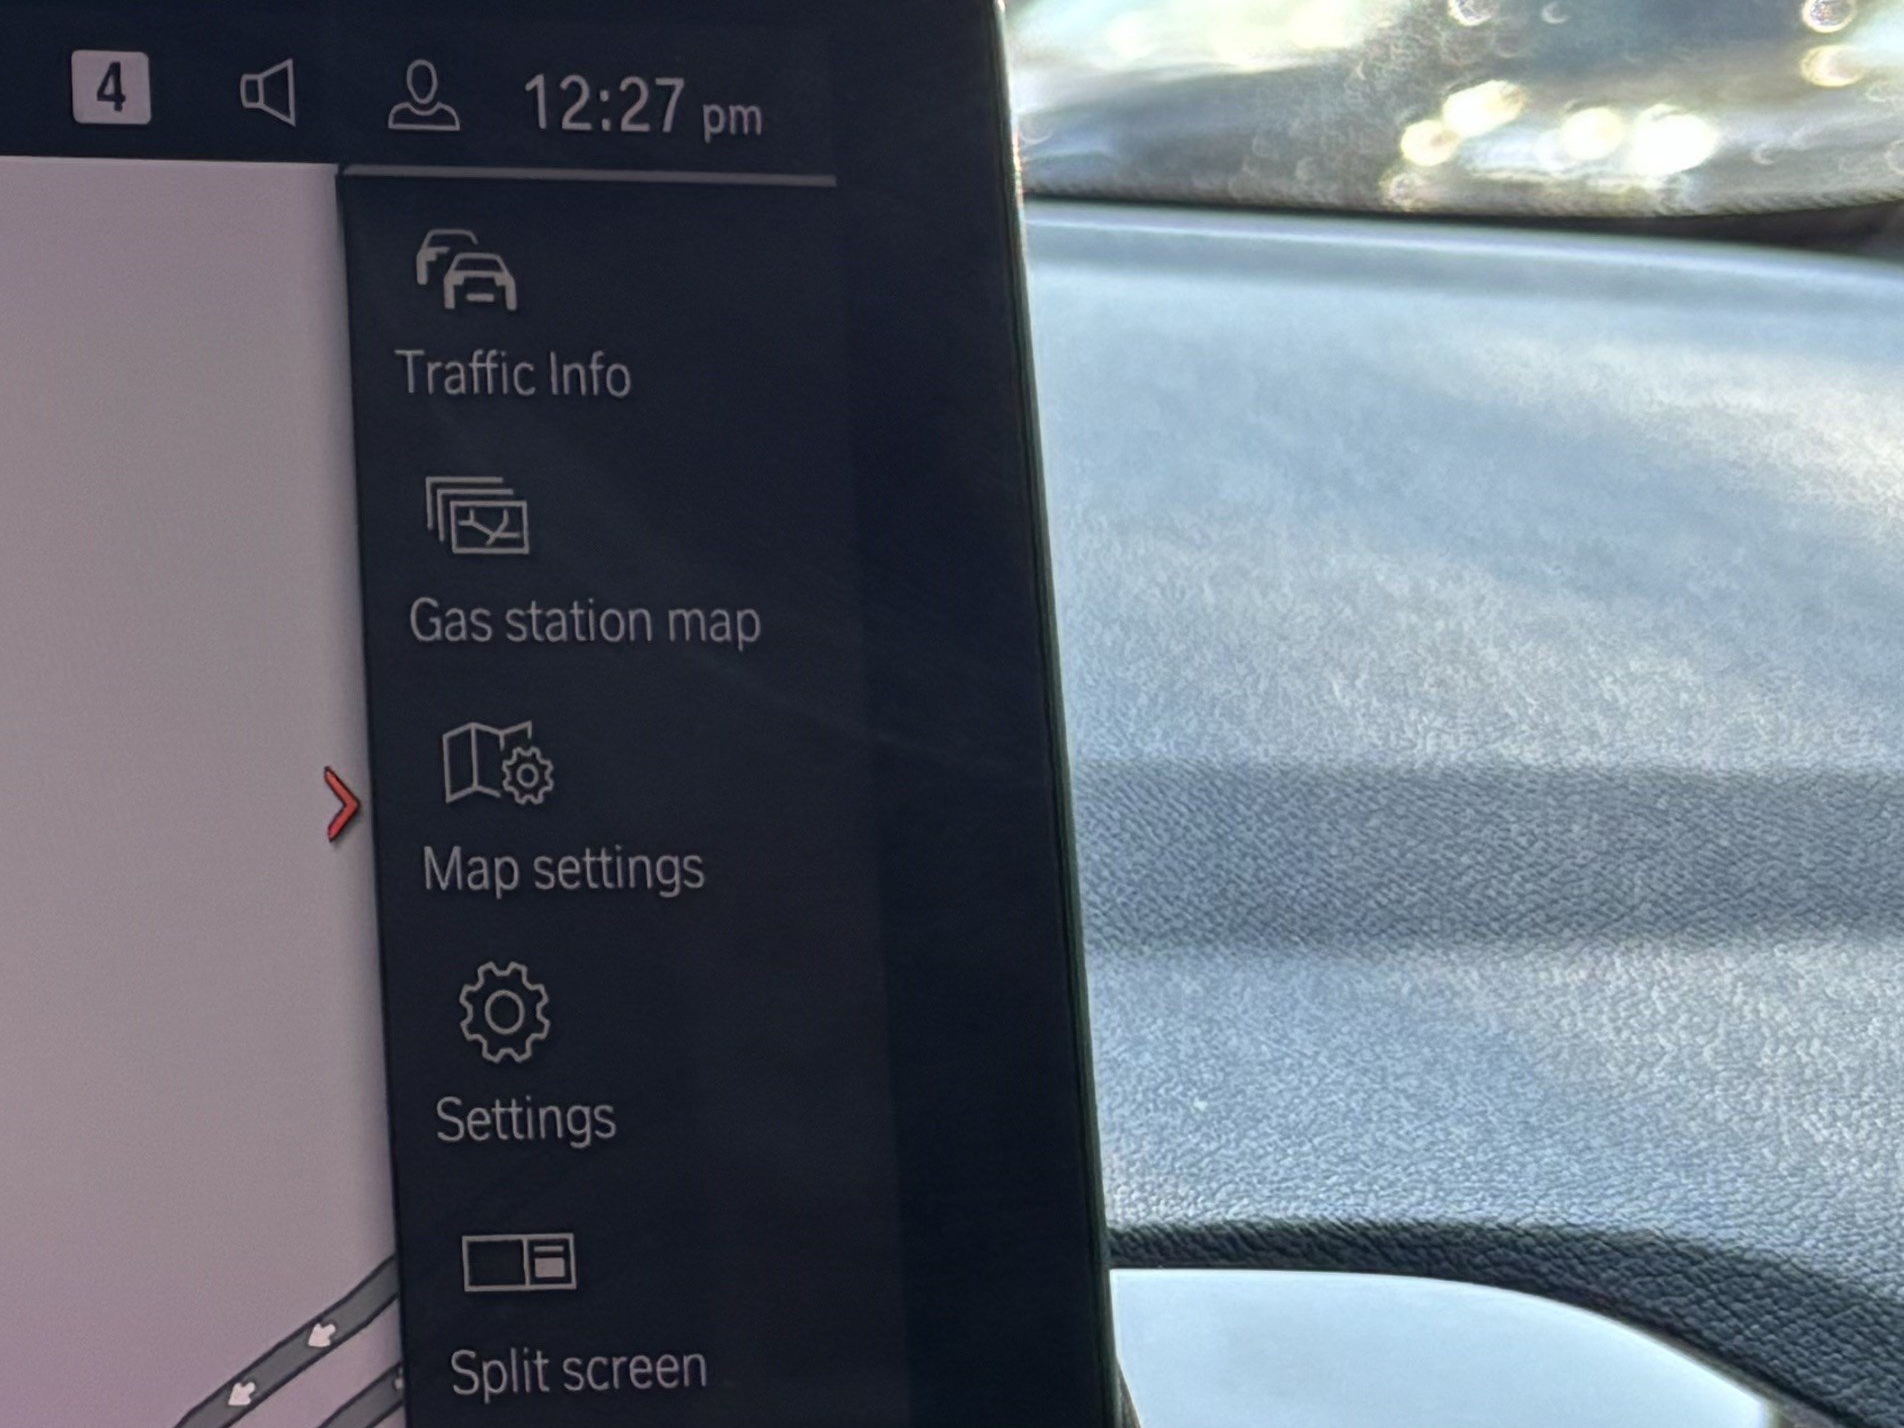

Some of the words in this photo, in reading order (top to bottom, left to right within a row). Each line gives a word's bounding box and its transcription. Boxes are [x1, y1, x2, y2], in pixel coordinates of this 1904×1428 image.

[96, 62, 126, 113] 4
[523, 74, 686, 135] 12:27
[702, 101, 762, 142] pm
[394, 349, 536, 396] Traffic
[549, 350, 632, 398] Info
[409, 597, 493, 643] Gas
[505, 598, 653, 643] station
[668, 607, 762, 652] map
[423, 845, 520, 899] Map
[533, 844, 706, 898] settings
[435, 1095, 617, 1149] Settings
[450, 1347, 550, 1404] Split
[562, 1352, 708, 1392] screen
